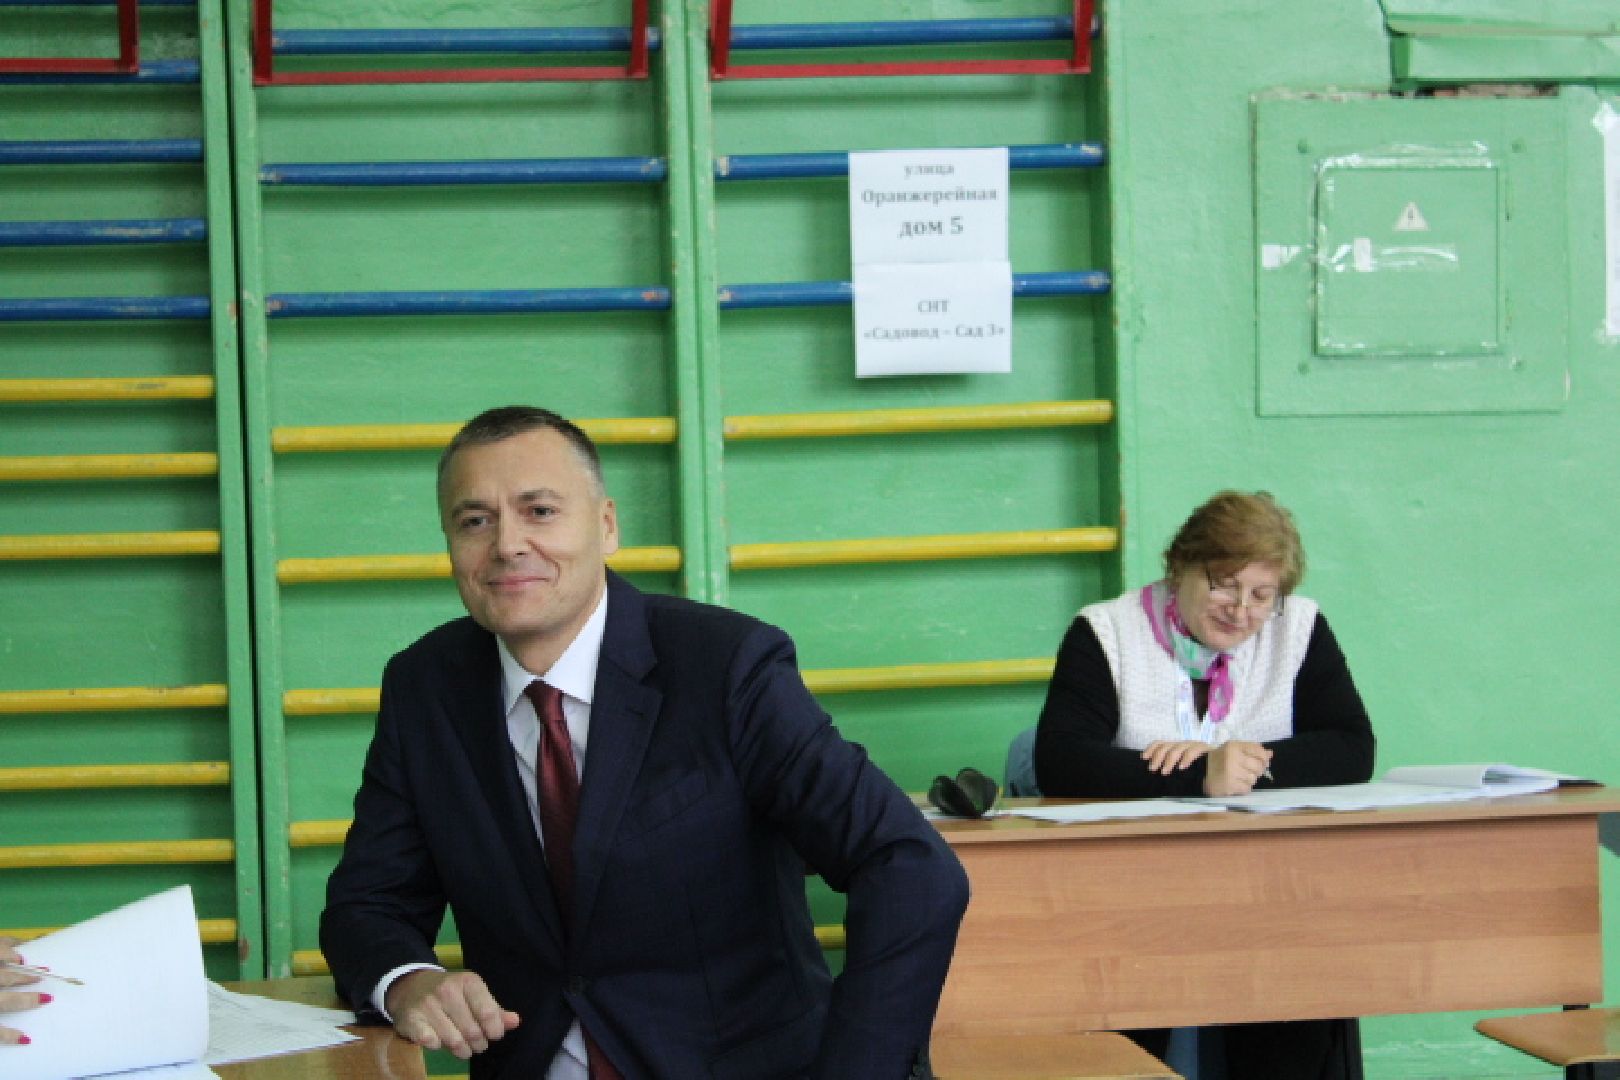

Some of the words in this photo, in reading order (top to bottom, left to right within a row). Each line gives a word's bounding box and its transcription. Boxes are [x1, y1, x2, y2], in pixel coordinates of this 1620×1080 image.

[904, 164, 954, 179] улица
[862, 187, 997, 207] Оранжерейная
[898, 220, 943, 239] дом
[950, 215, 964, 235] 5
[917, 299, 950, 313] СНТ
[955, 323, 983, 339] Сад
